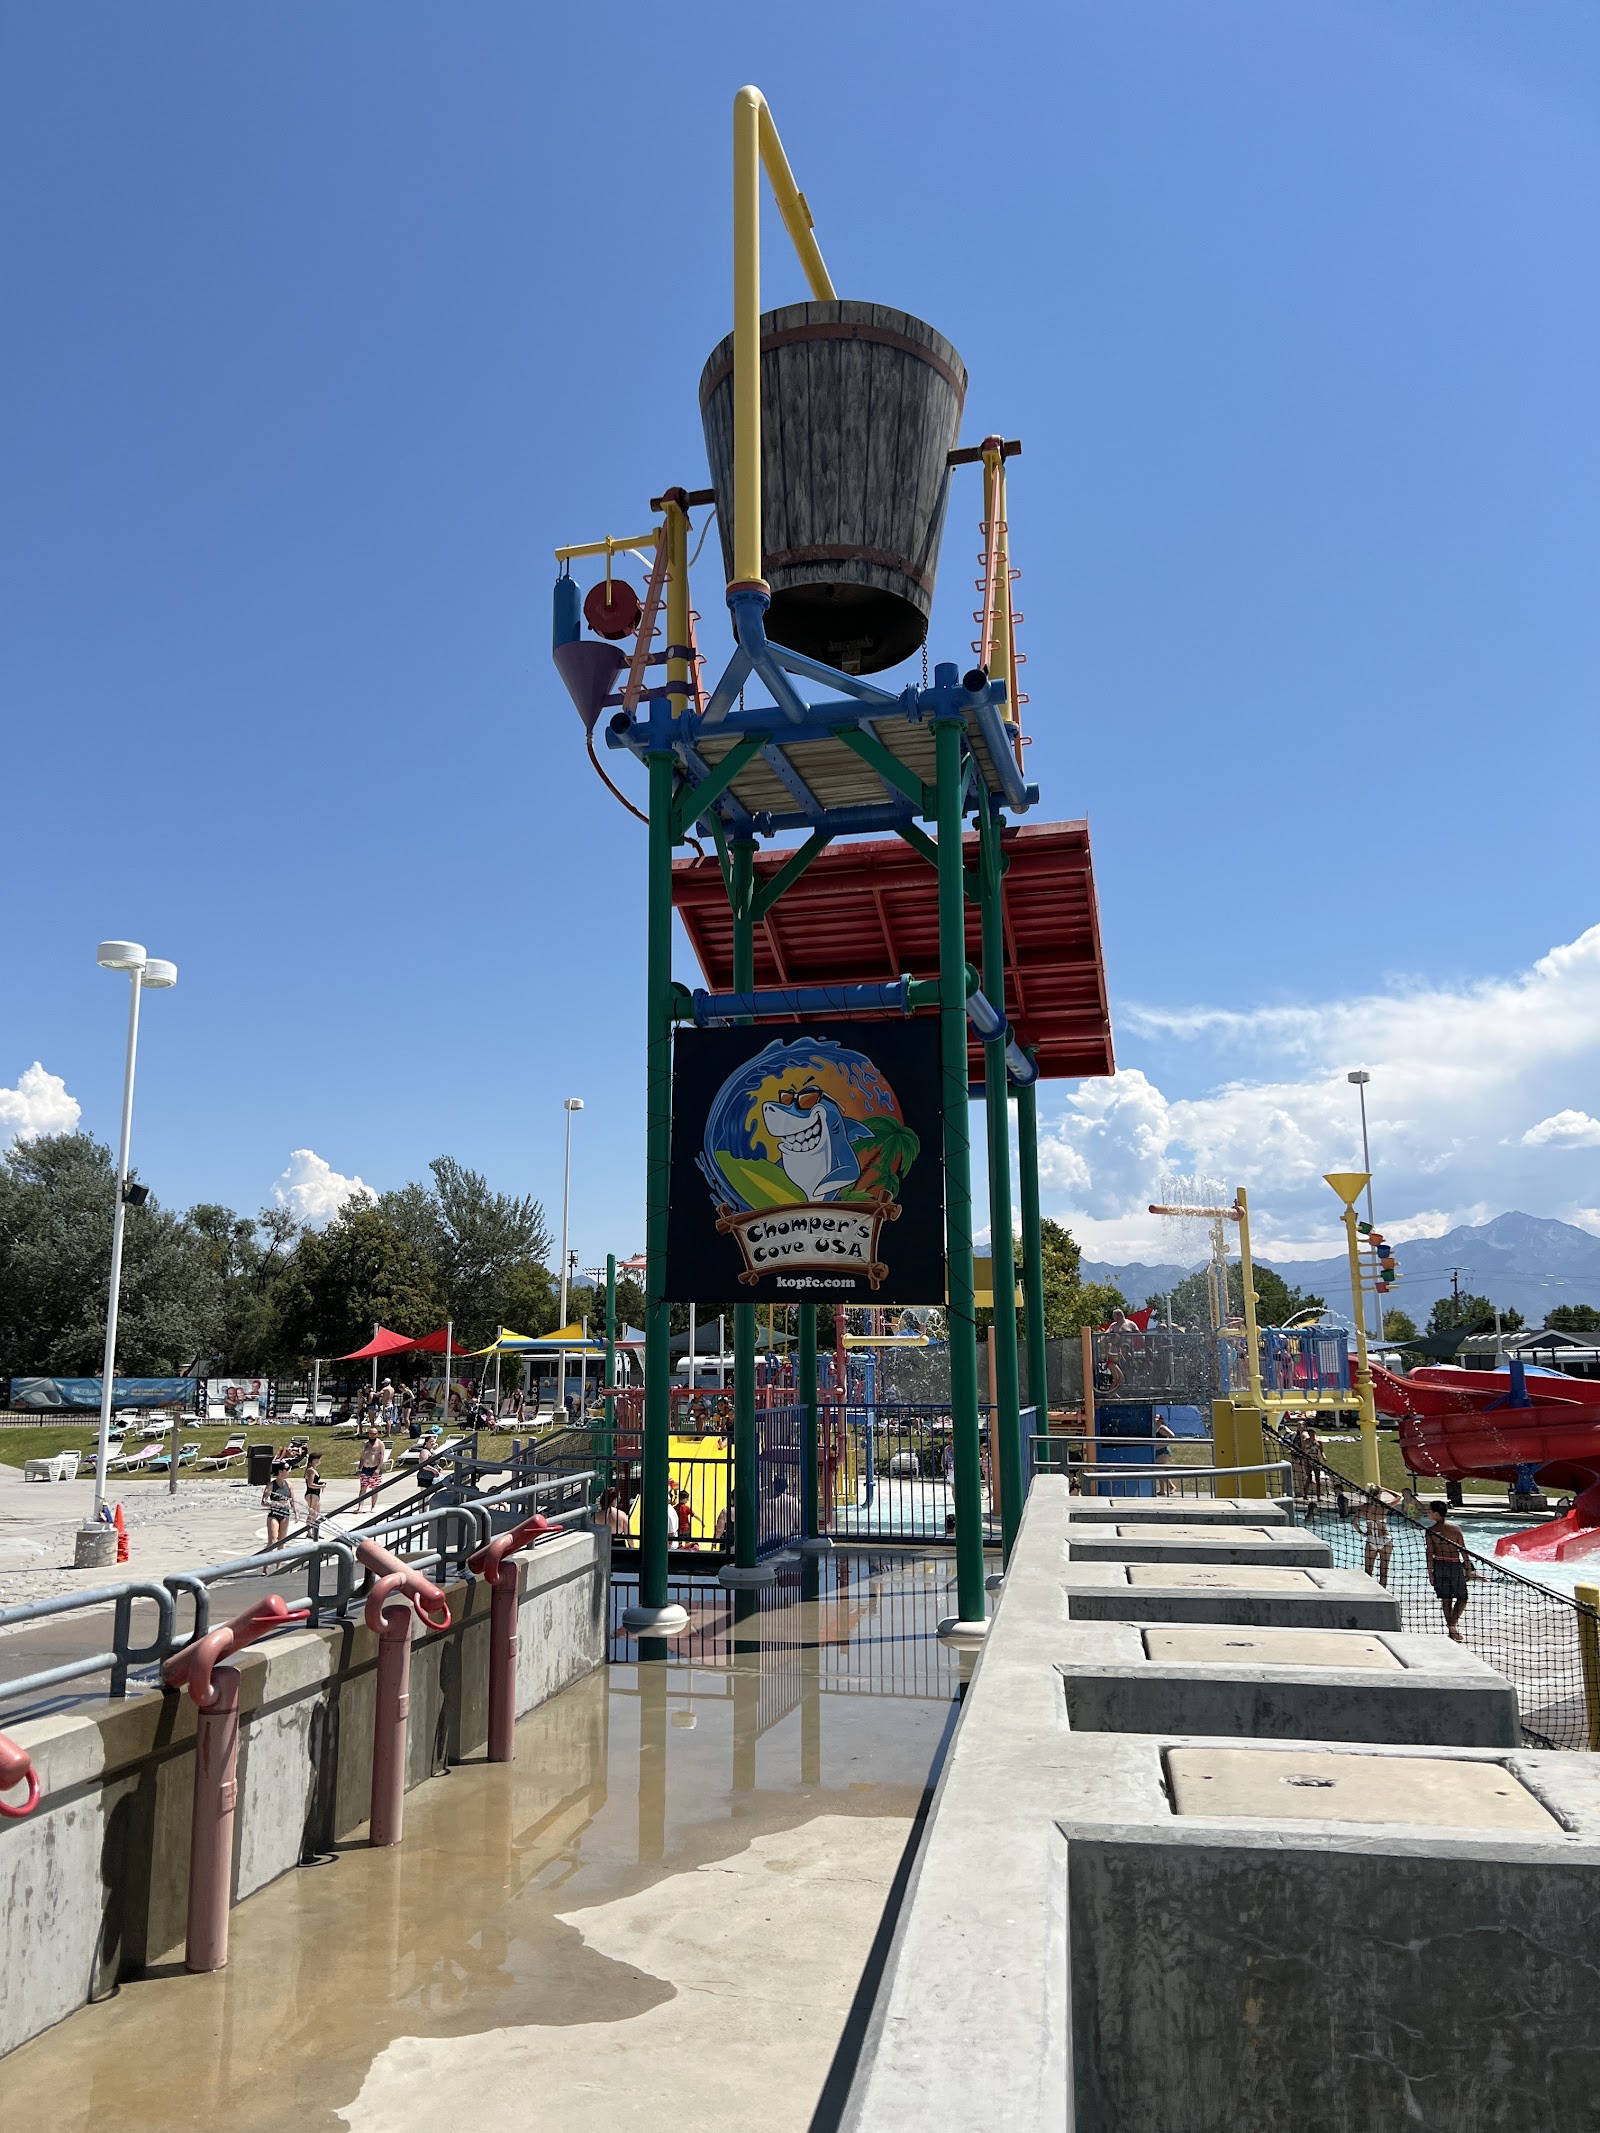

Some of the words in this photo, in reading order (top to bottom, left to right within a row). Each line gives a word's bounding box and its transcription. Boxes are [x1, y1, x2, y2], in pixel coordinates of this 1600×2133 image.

[747, 1217, 870, 1242] Chomper's
[753, 1241, 805, 1262] Cove
[814, 1237, 863, 1257] USA
[776, 1276, 856, 1289] kopfc.com
[268, 1382, 276, 1417] KOPFC
